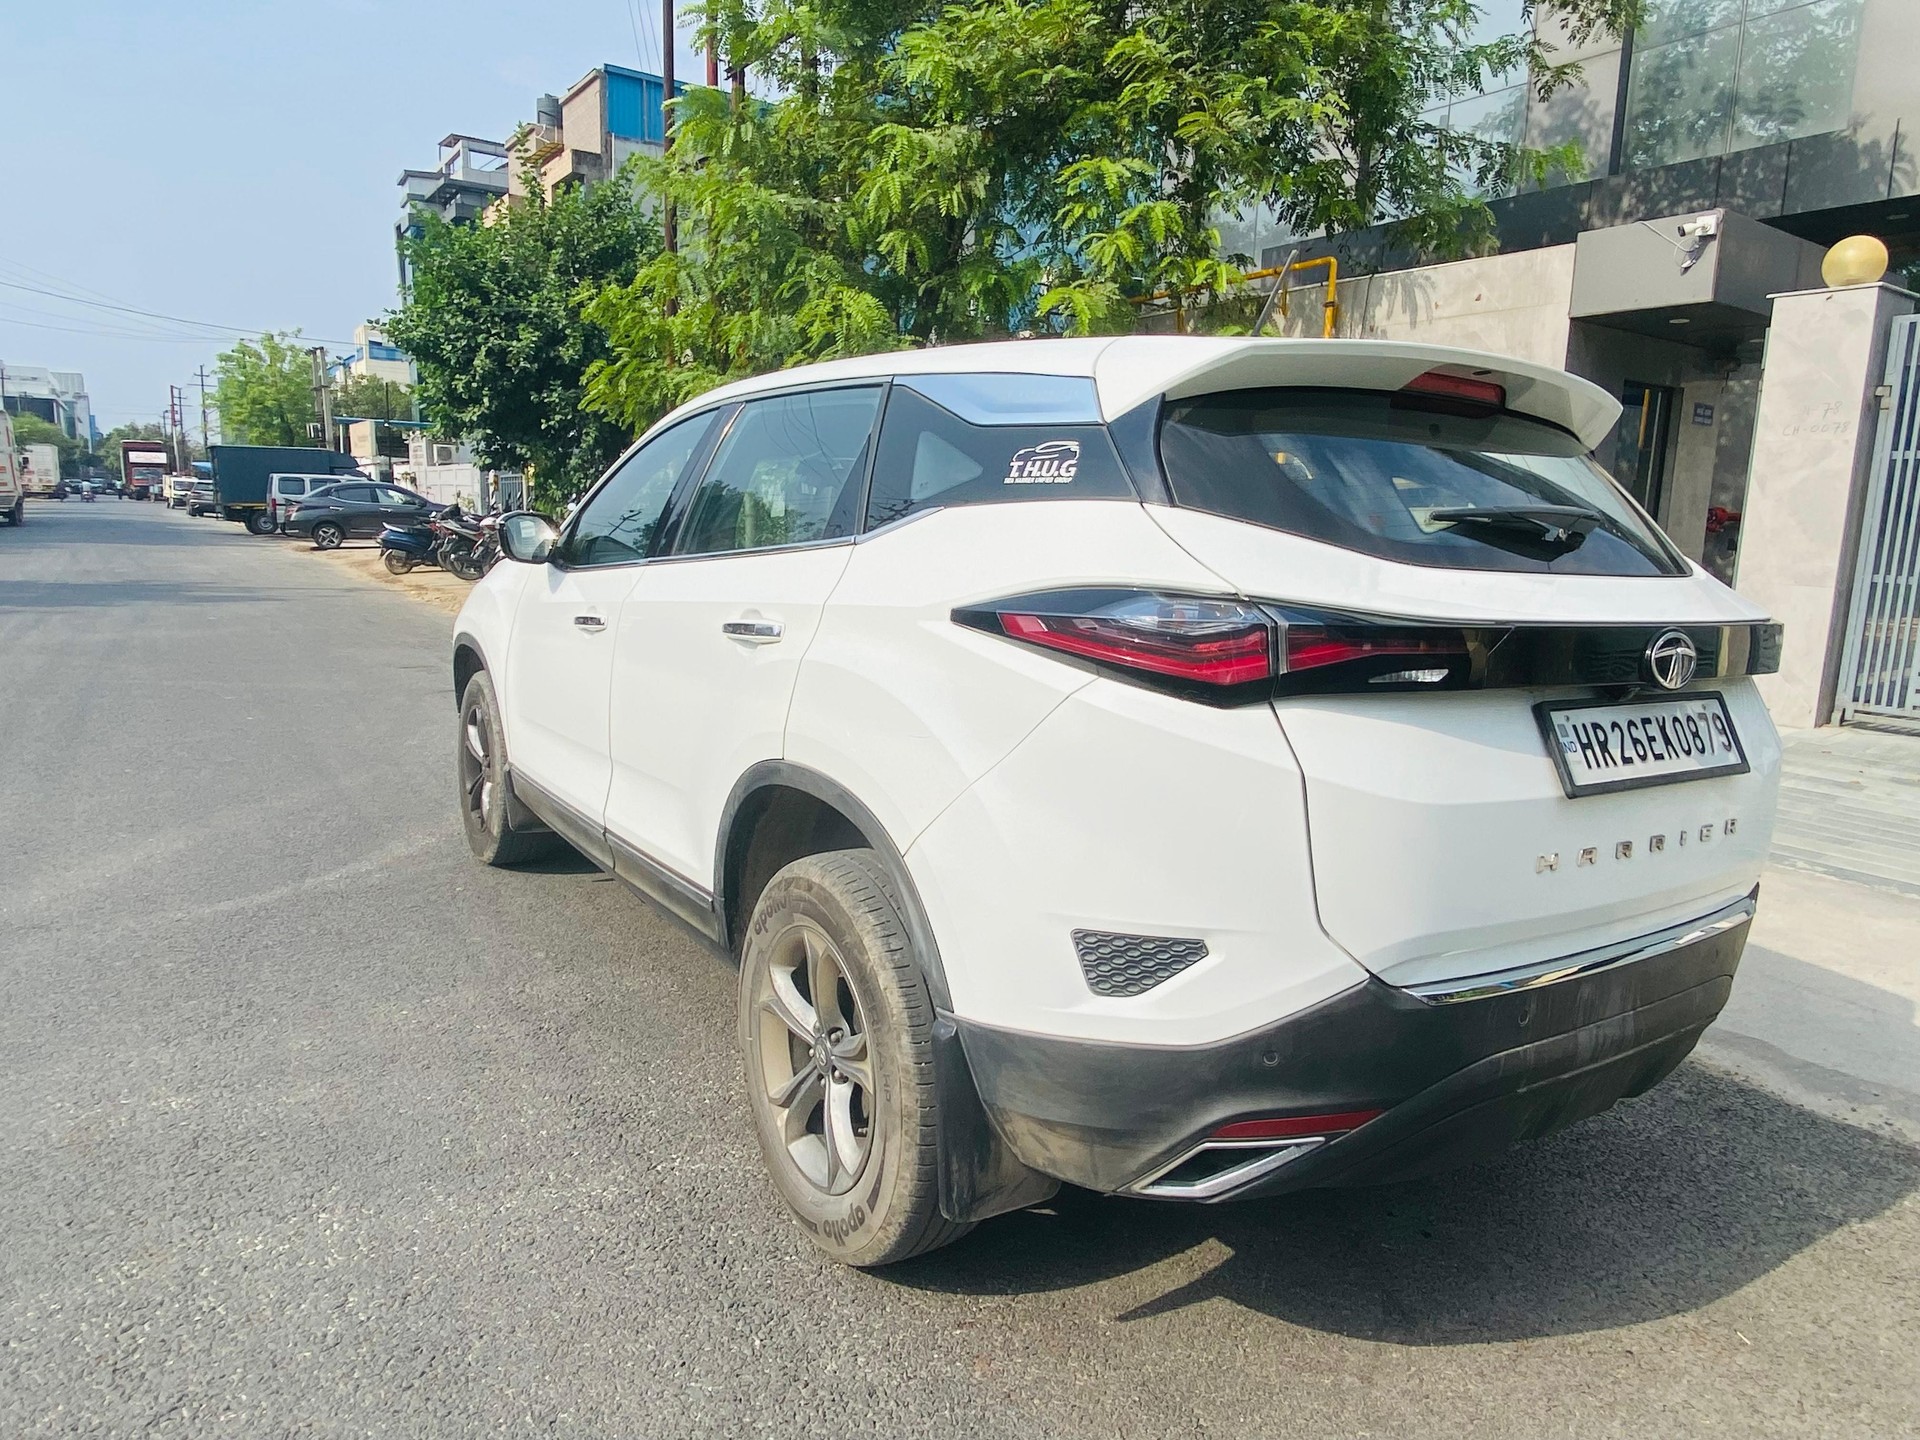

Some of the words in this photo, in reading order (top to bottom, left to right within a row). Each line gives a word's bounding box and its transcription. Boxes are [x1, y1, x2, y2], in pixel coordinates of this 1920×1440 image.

[1572, 711, 1732, 769] HR26EK0879
[1536, 818, 1737, 873] HARRIER
[823, 1203, 866, 1247] apollo
